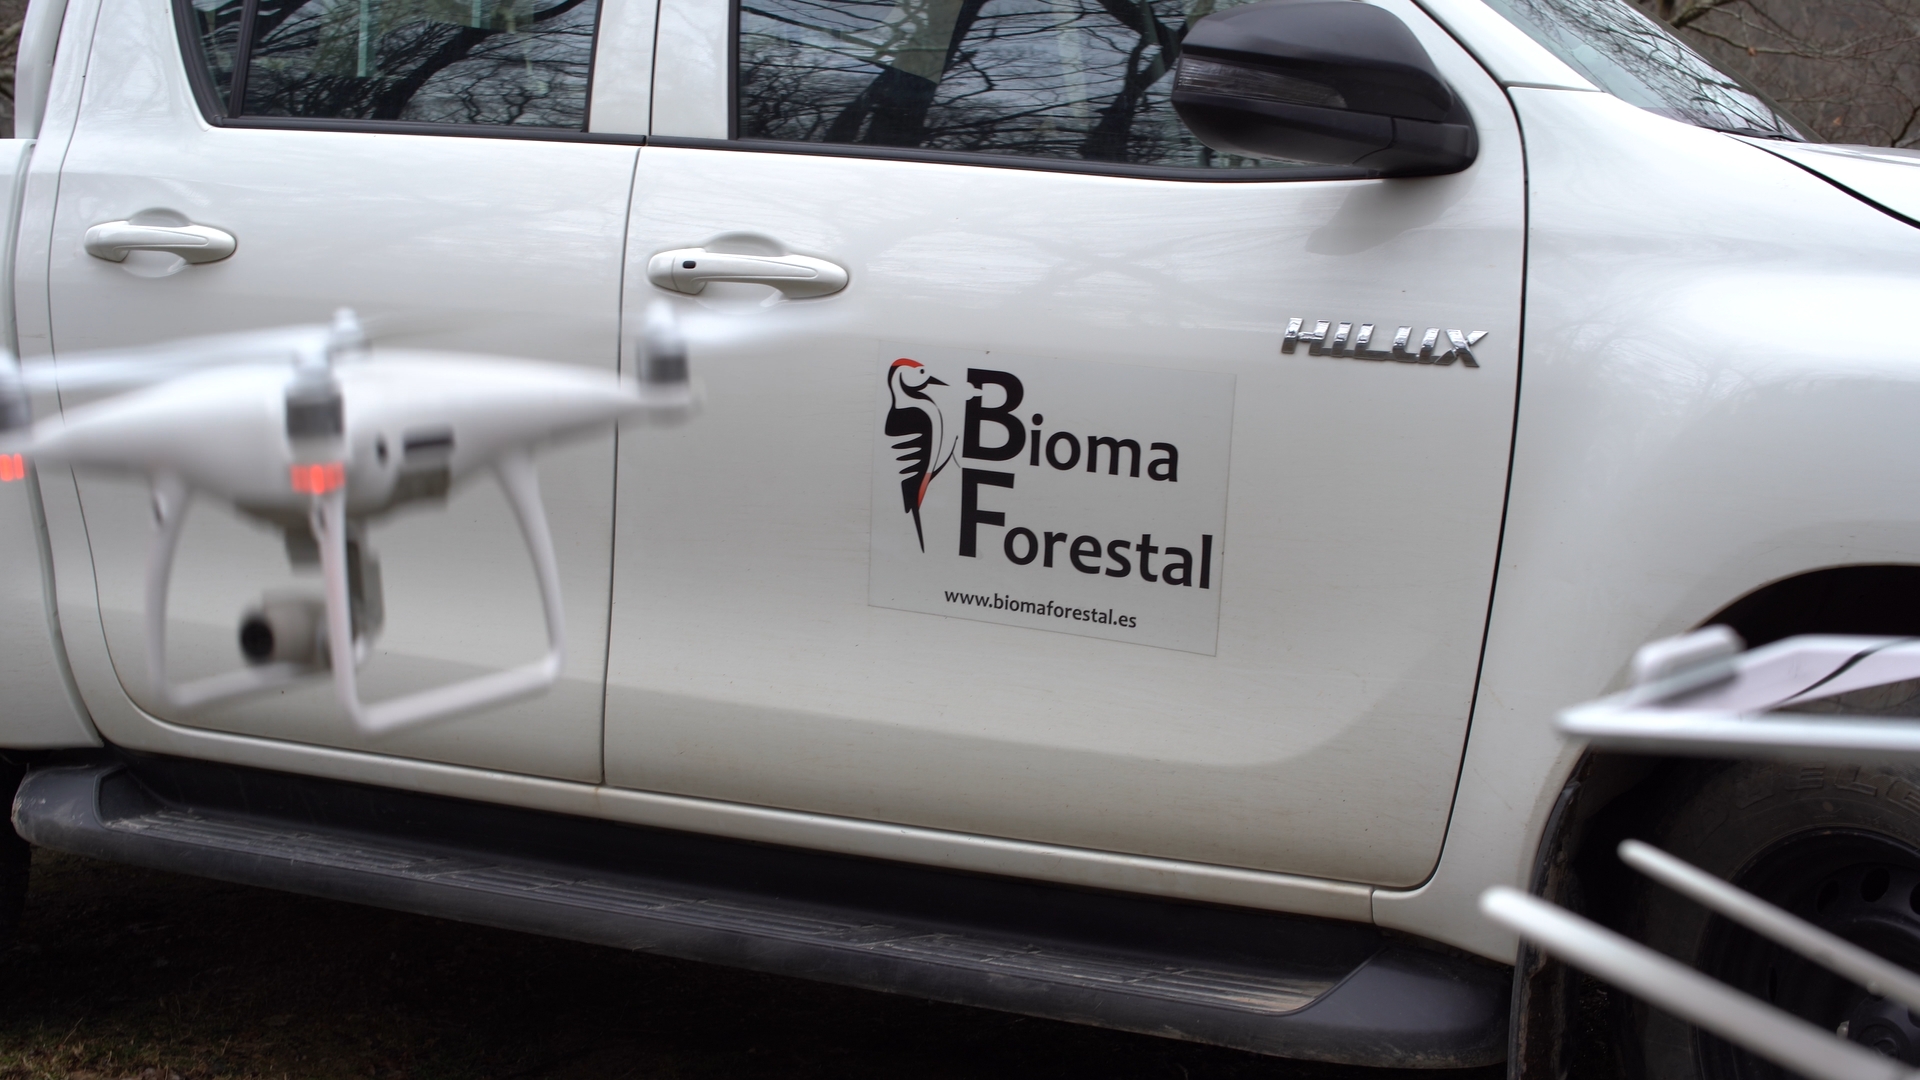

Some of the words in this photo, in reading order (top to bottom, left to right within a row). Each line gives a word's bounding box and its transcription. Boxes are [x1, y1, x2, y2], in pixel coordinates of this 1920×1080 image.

[1281, 317, 1489, 368] HILUX
[962, 367, 1179, 482] Bioma
[959, 467, 1213, 589] Forestal
[944, 590, 1137, 628] www.biomaforestal.es
